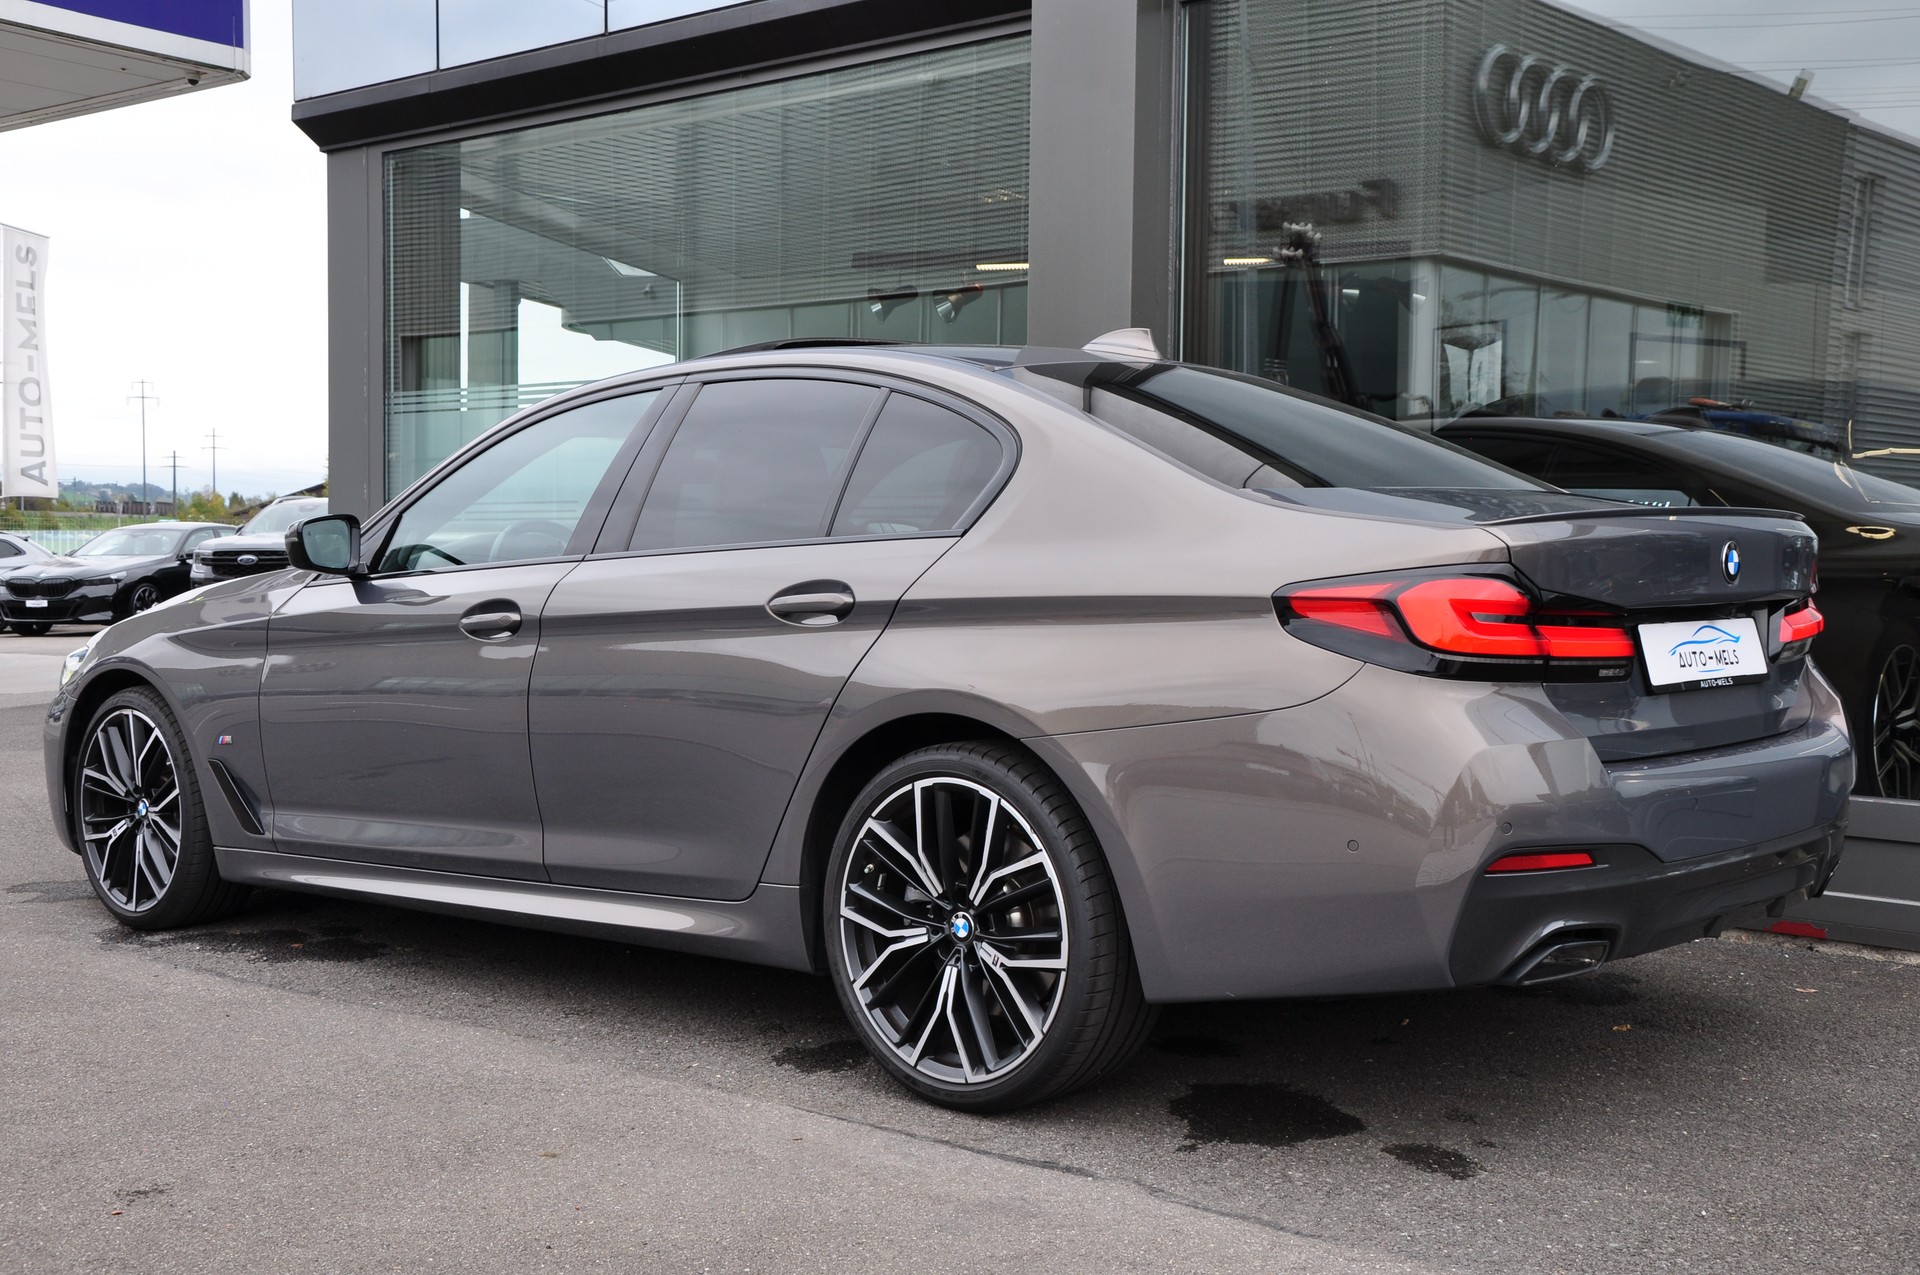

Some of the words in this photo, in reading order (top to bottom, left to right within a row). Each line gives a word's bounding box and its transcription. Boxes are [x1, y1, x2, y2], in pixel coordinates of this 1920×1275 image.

[16, 245, 49, 486] AUTO-MELS
[1679, 650, 1740, 668] AUTO-MELS
[1700, 678, 1733, 688] AUTO-MELS
